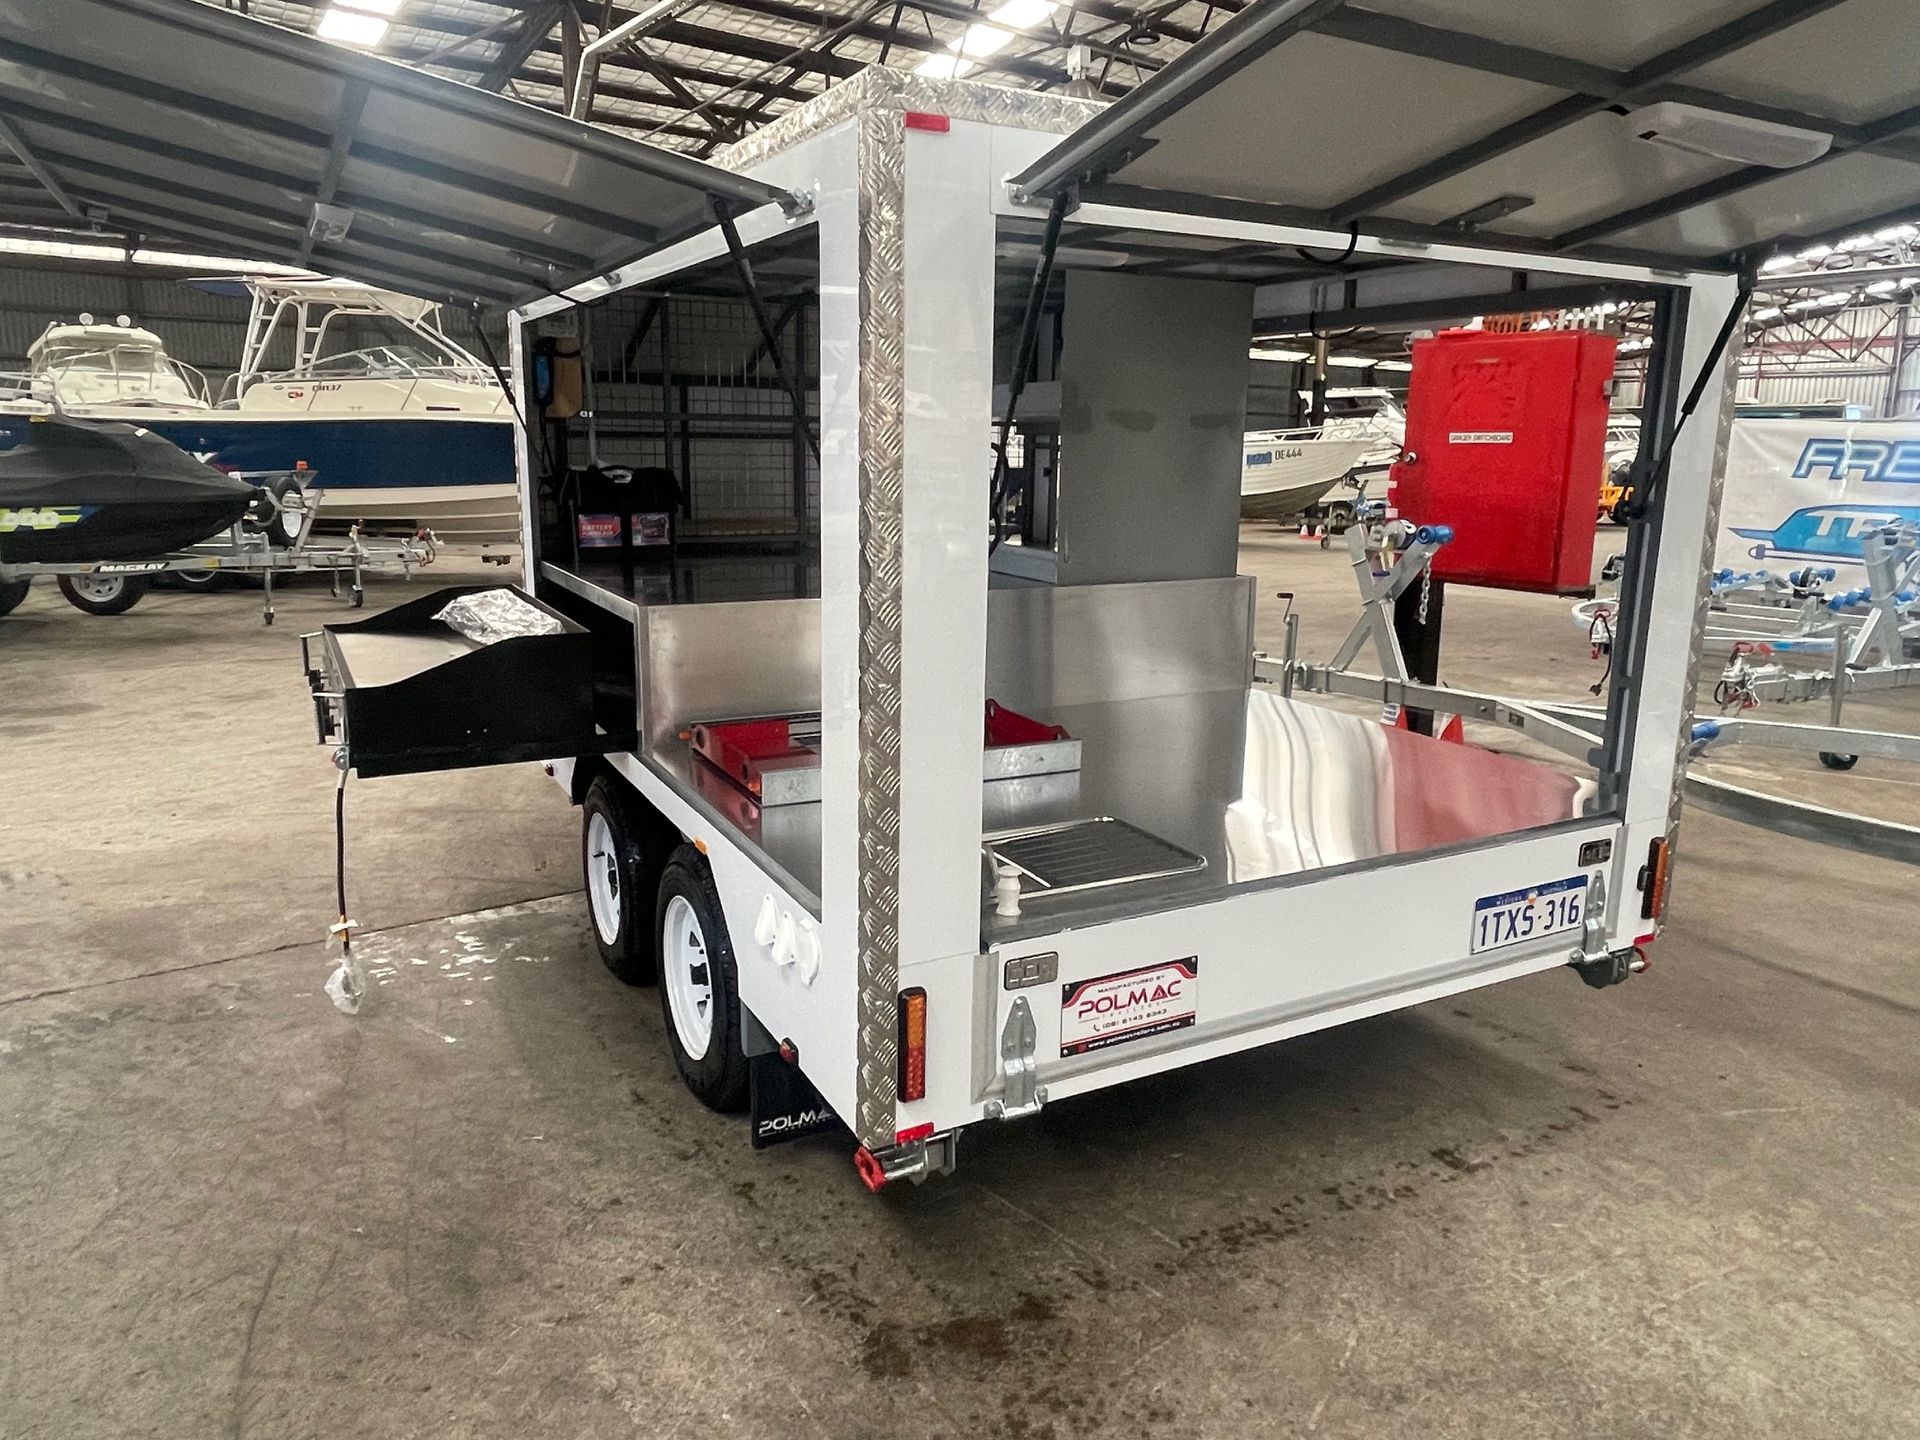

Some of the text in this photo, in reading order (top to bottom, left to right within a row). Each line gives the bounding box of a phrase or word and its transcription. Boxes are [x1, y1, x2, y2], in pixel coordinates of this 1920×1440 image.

[100, 562, 165, 573] MACKAY
[1097, 977, 1154, 993] MANUFACTURED
[1078, 979, 1182, 1019] POLMAC
[1102, 1018, 1119, 1029] (08)
[1121, 1014, 1143, 1024] 6143
